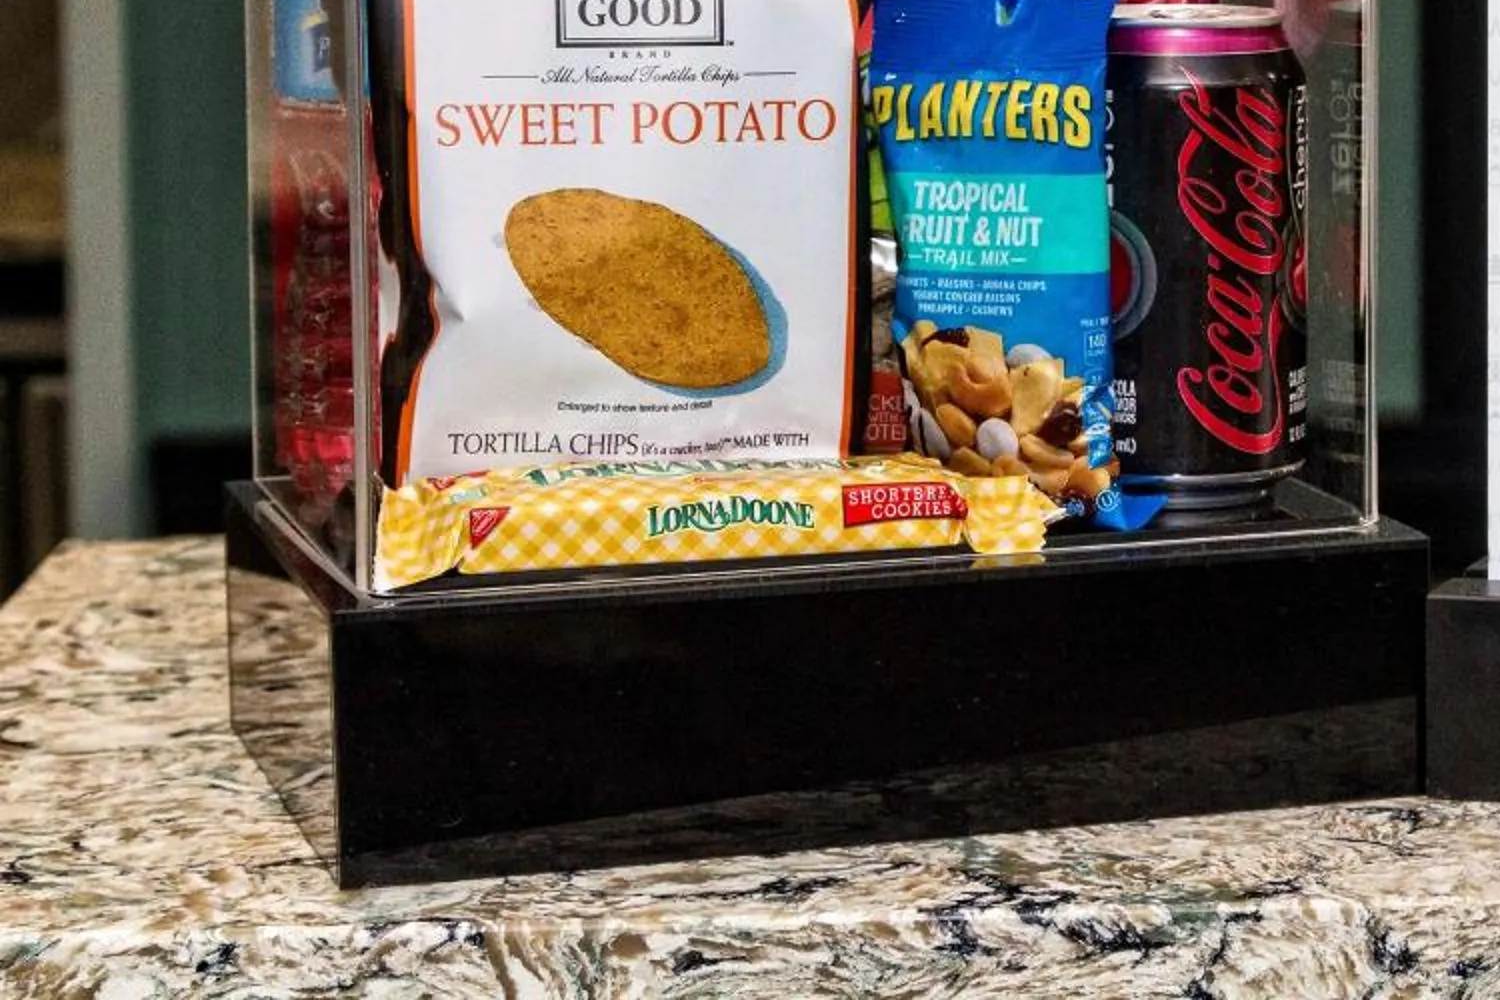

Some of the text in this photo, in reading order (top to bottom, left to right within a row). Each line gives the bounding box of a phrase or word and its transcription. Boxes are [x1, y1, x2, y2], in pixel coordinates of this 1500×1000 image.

[609, 50, 671, 60] BRAND
[541, 63, 741, 87] All Natural Tortilla Chips
[436, 99, 838, 148] SWEET POTATO
[871, 79, 1093, 150] PLANTERS
[914, 180, 1030, 213] TROPICAL
[973, 216, 990, 247] &
[996, 216, 1044, 248] NUT
[922, 247, 1009, 270] TRAIL MIX
[1177, 65, 1286, 455] Coca-Cola
[917, 303, 964, 315] PINEAPPLE
[557, 400, 598, 413] Enlarged
[602, 402, 610, 412] to
[612, 402, 636, 412] show
[672, 401, 688, 411] and
[447, 431, 809, 457] TORTILLA CHIPS MADE WITH
[849, 484, 965, 513] SHORTBRE
[871, 500, 953, 521] COOKIES
